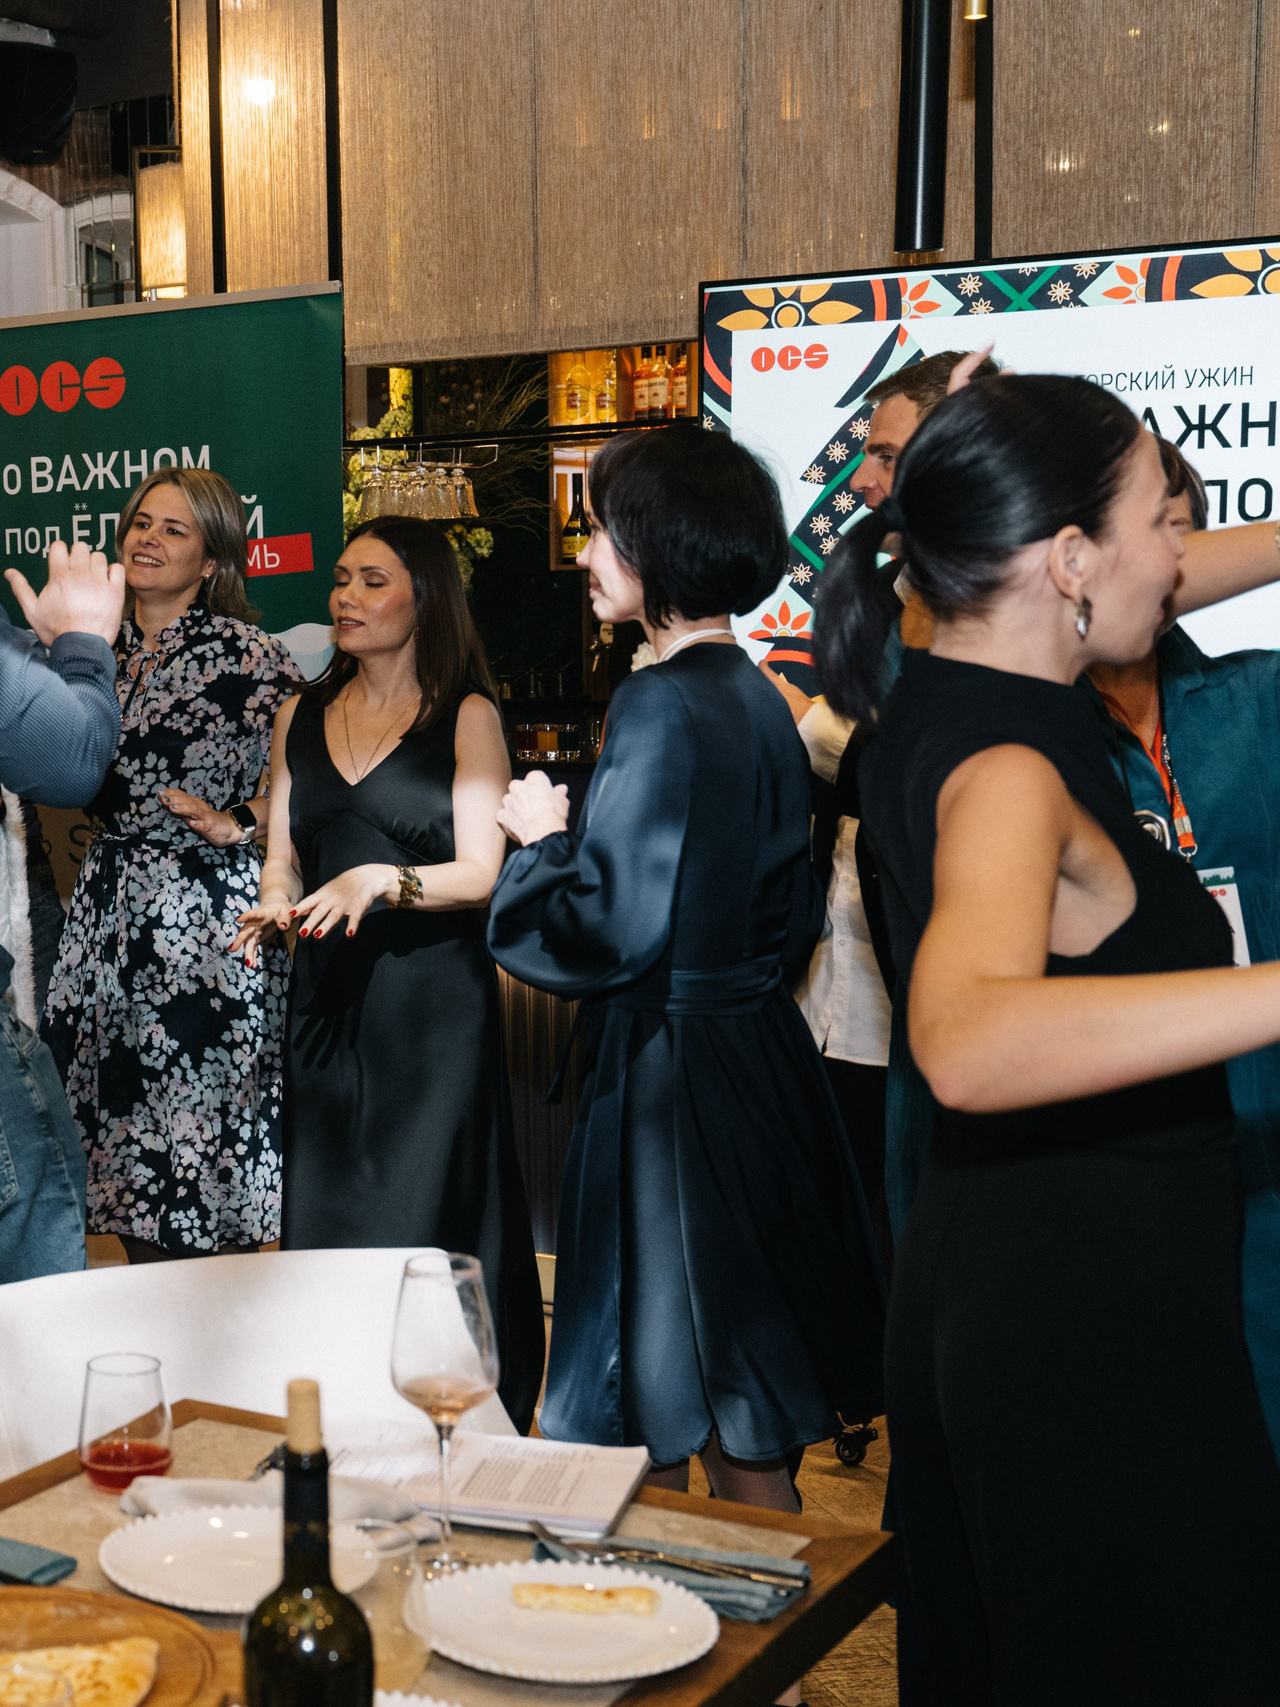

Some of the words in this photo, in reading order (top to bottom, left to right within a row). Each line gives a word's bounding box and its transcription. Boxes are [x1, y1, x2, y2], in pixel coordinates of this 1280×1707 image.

[751, 343, 829, 372] OCS
[1079, 364, 1175, 392] ОРСКИЙ
[1184, 365, 1254, 389] УЖИН
[1141, 401, 1277, 449] АЖН
